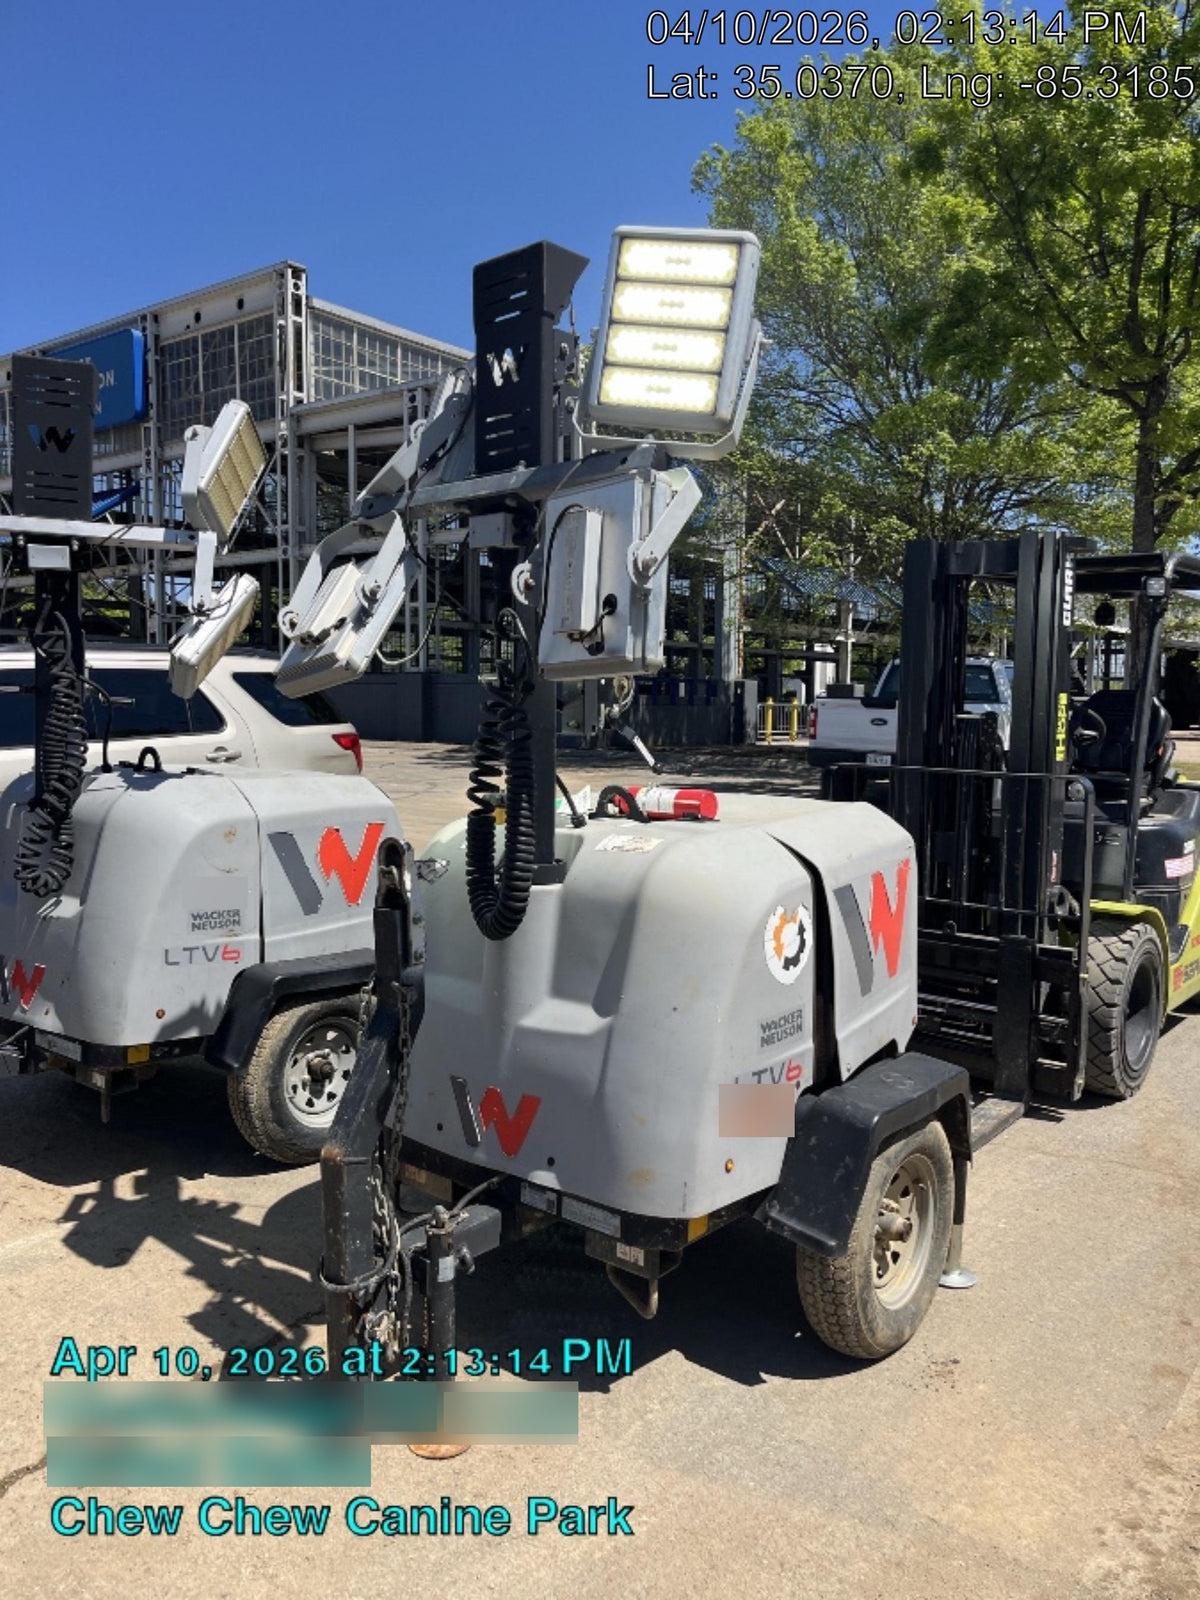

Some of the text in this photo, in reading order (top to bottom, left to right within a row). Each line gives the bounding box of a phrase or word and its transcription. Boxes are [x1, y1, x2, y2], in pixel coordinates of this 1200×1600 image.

[190, 909, 241, 922] WACKER
[191, 919, 241, 932] NEUSON
[164, 943, 242, 966] LTV6
[760, 1008, 803, 1034] WACKER
[760, 1022, 803, 1048] NEUSON
